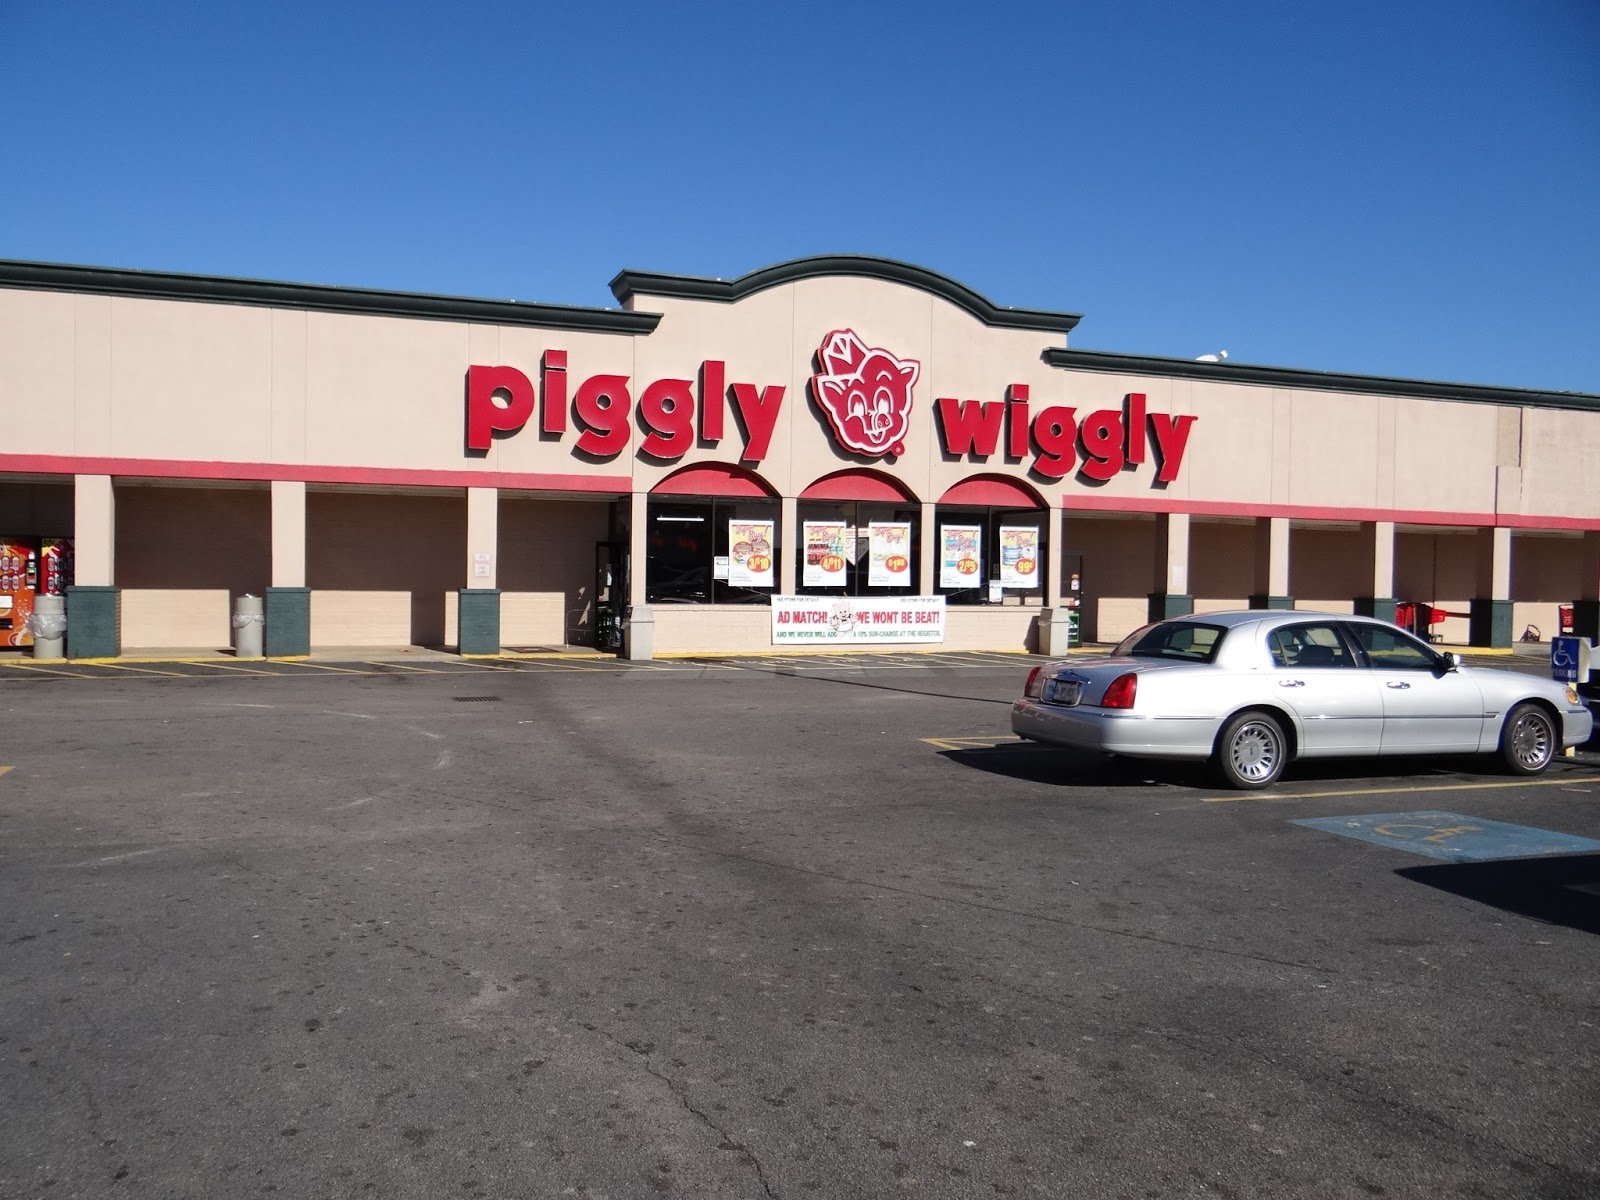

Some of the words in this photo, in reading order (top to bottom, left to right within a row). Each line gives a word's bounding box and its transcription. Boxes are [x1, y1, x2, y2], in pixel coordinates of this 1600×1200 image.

[468, 349, 787, 462] piggly
[939, 384, 1199, 482] wiggly
[777, 611, 790, 624] AD
[793, 611, 828, 624] MATCH!
[856, 611, 870, 624] WE
[901, 611, 913, 624] BE
[915, 611, 940, 624] BEAT!
